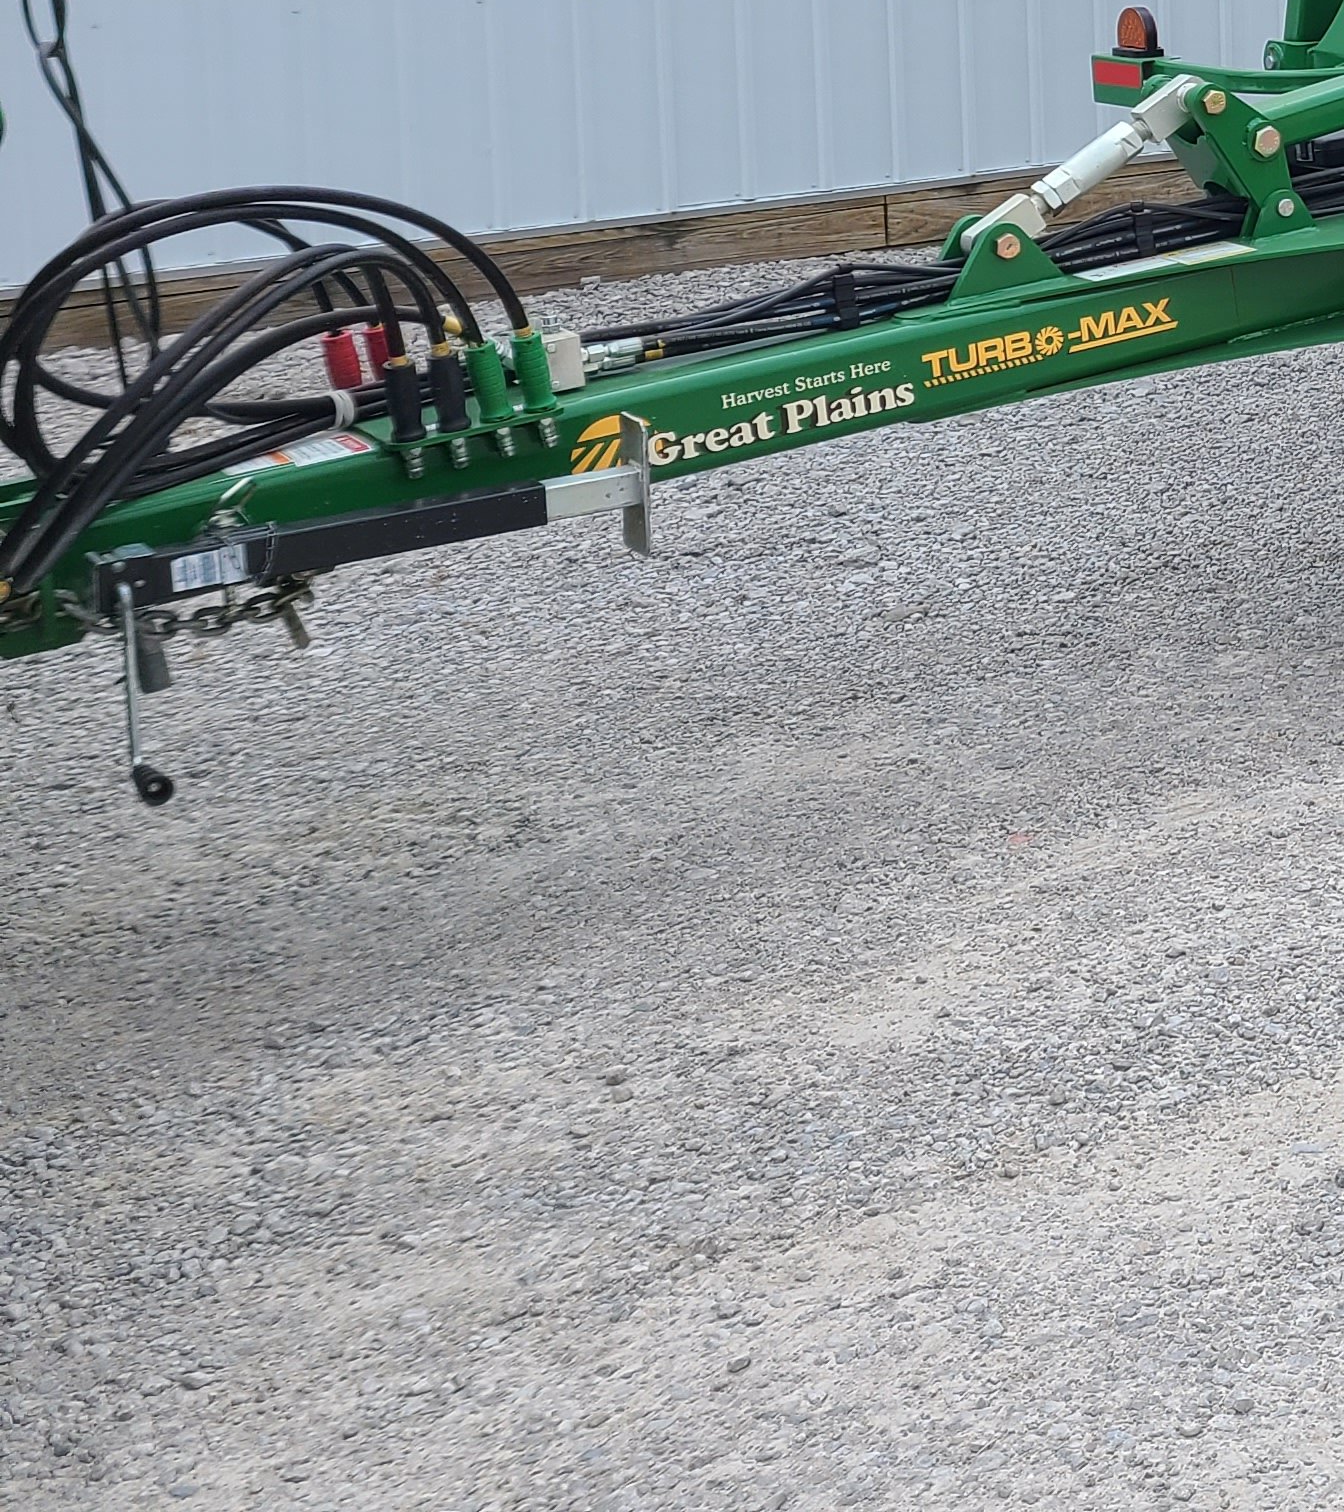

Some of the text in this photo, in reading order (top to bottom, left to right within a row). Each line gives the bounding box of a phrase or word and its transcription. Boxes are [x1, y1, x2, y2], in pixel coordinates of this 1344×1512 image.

[921, 298, 1173, 378] TURBO-MAX
[647, 383, 915, 467] Great Plains
[721, 360, 892, 410] Harvest Starts Here
